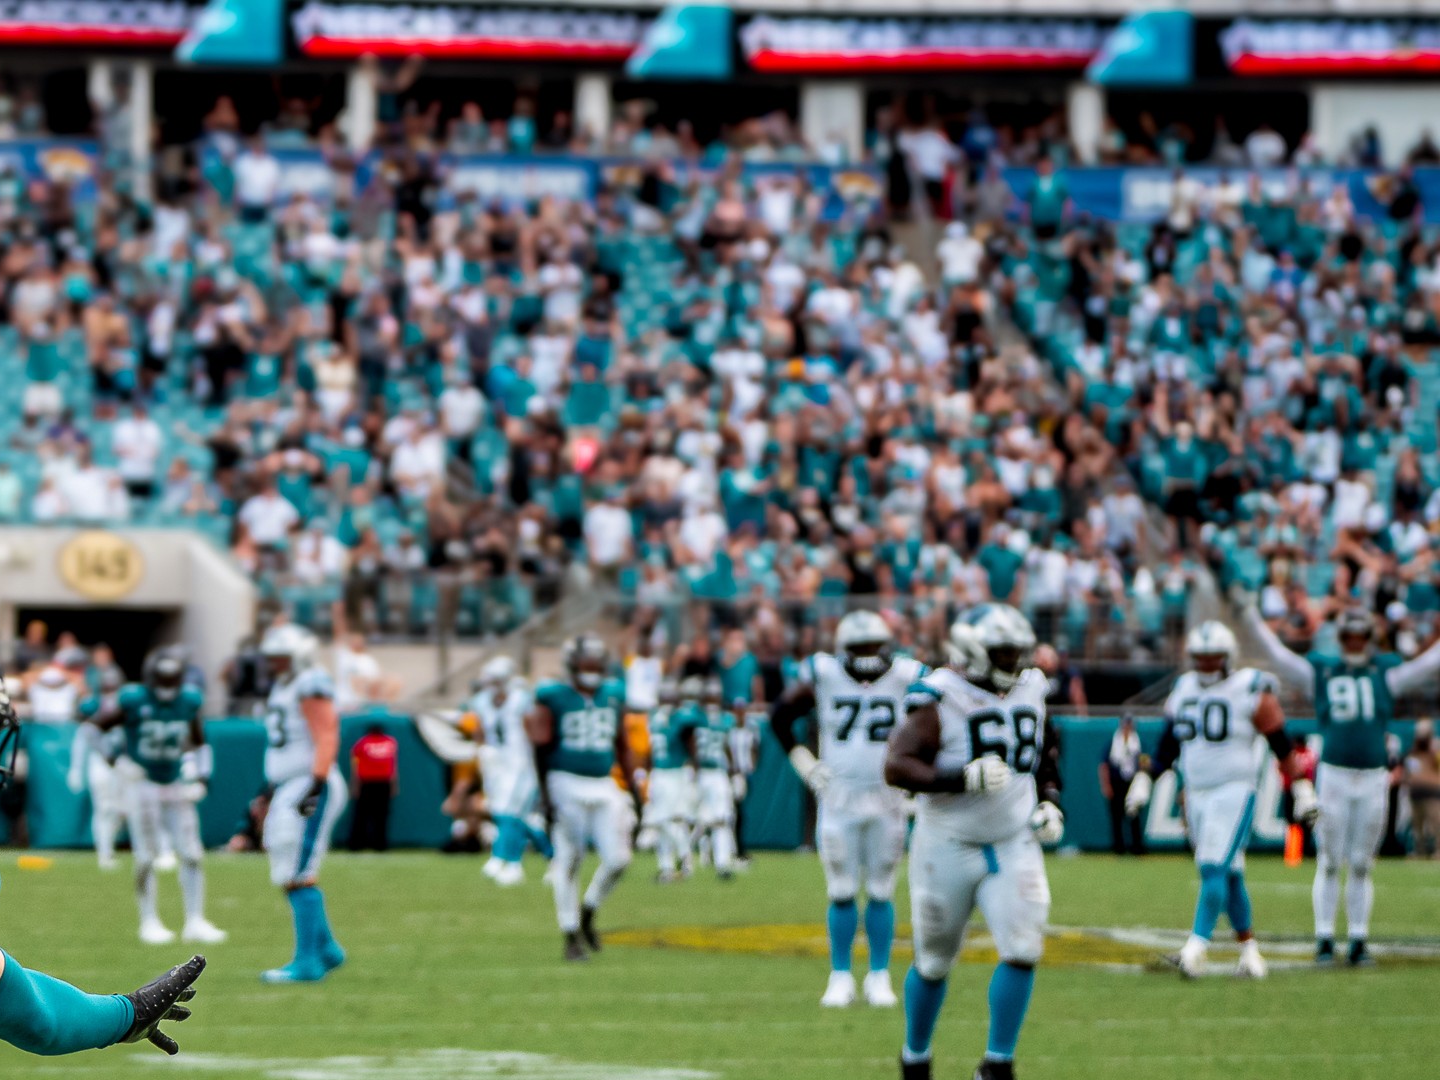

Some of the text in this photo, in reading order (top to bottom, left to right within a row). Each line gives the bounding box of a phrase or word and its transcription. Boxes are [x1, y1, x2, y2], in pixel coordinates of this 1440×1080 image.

[831, 697, 896, 743] 72
[1173, 698, 1229, 743] 50
[1327, 675, 1374, 722] 91
[968, 703, 1040, 774] 68
